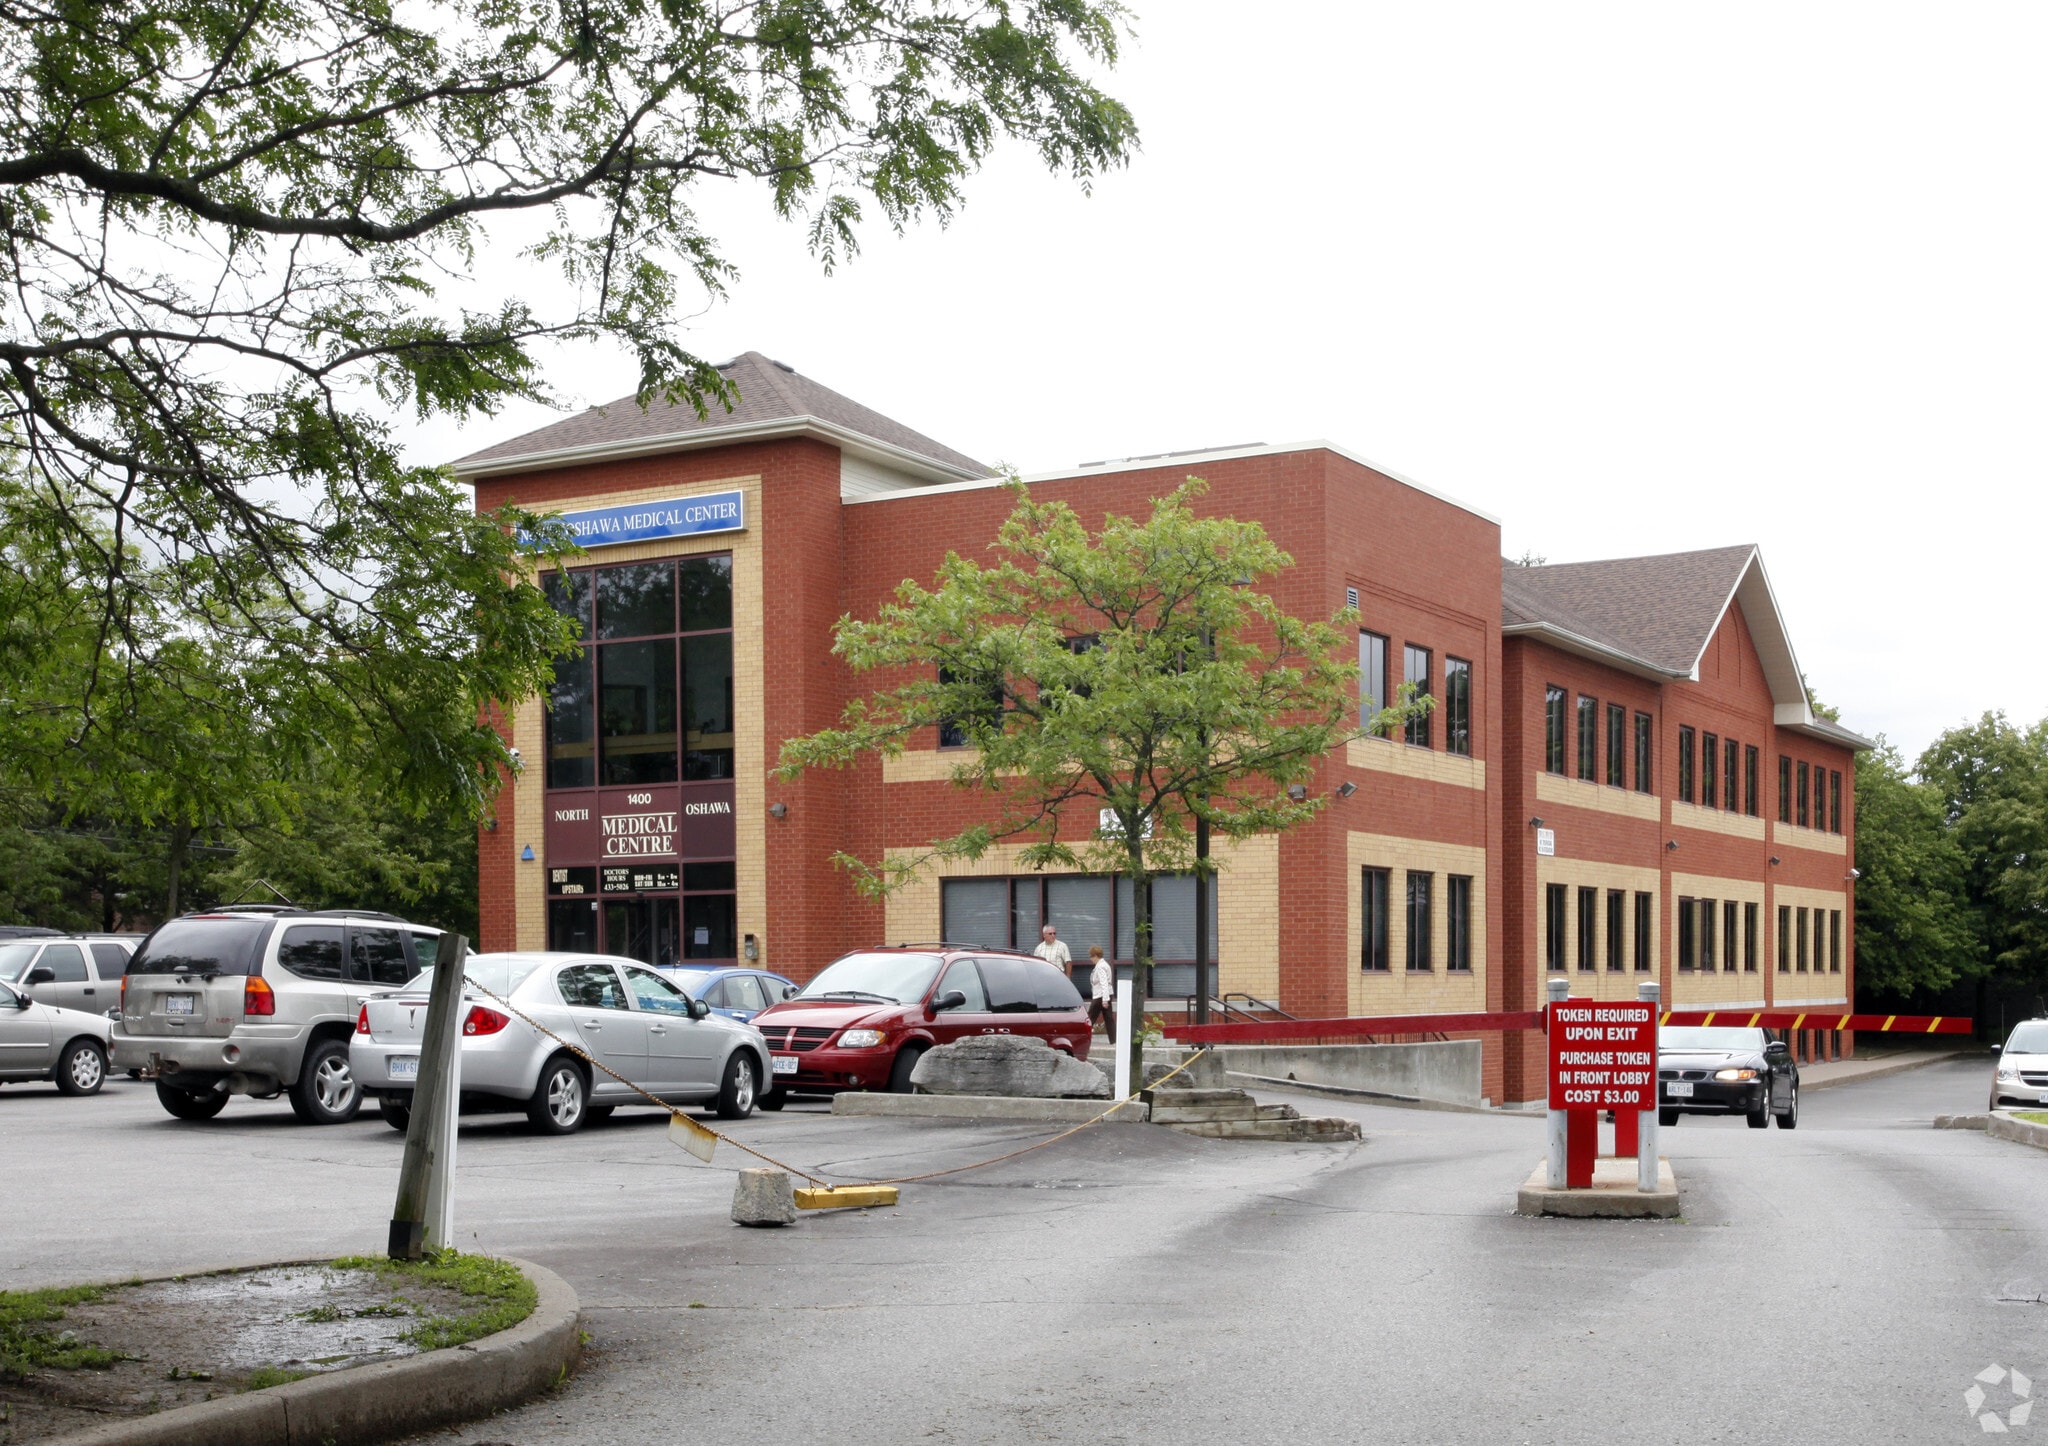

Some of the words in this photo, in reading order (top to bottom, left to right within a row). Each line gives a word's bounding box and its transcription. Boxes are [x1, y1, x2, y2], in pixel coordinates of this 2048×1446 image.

[623, 509, 682, 531] MEDICAL
[685, 502, 738, 523] CENTER
[627, 793, 652, 804] 1400
[555, 809, 589, 822] NORTH
[685, 802, 731, 815] OSHAWA
[602, 815, 678, 836] MEDICAL
[606, 835, 673, 855] CENTRE
[603, 868, 629, 876] DOCTORS
[1556, 1009, 1592, 1022] TOKEN
[1595, 1009, 1649, 1023] REQUIRED
[1565, 1027, 1603, 1041] UPON
[1607, 1027, 1638, 1040] EXIT
[1559, 1051, 1613, 1065] PURCHASE
[1616, 1052, 1651, 1065] TOKEN
[1559, 1071, 1571, 1084] IN
[1574, 1071, 1611, 1084] FRONT
[1613, 1072, 1651, 1085] LOBBY
[1564, 1089, 1600, 1102] COST
[1604, 1090, 1640, 1104] $3.00
